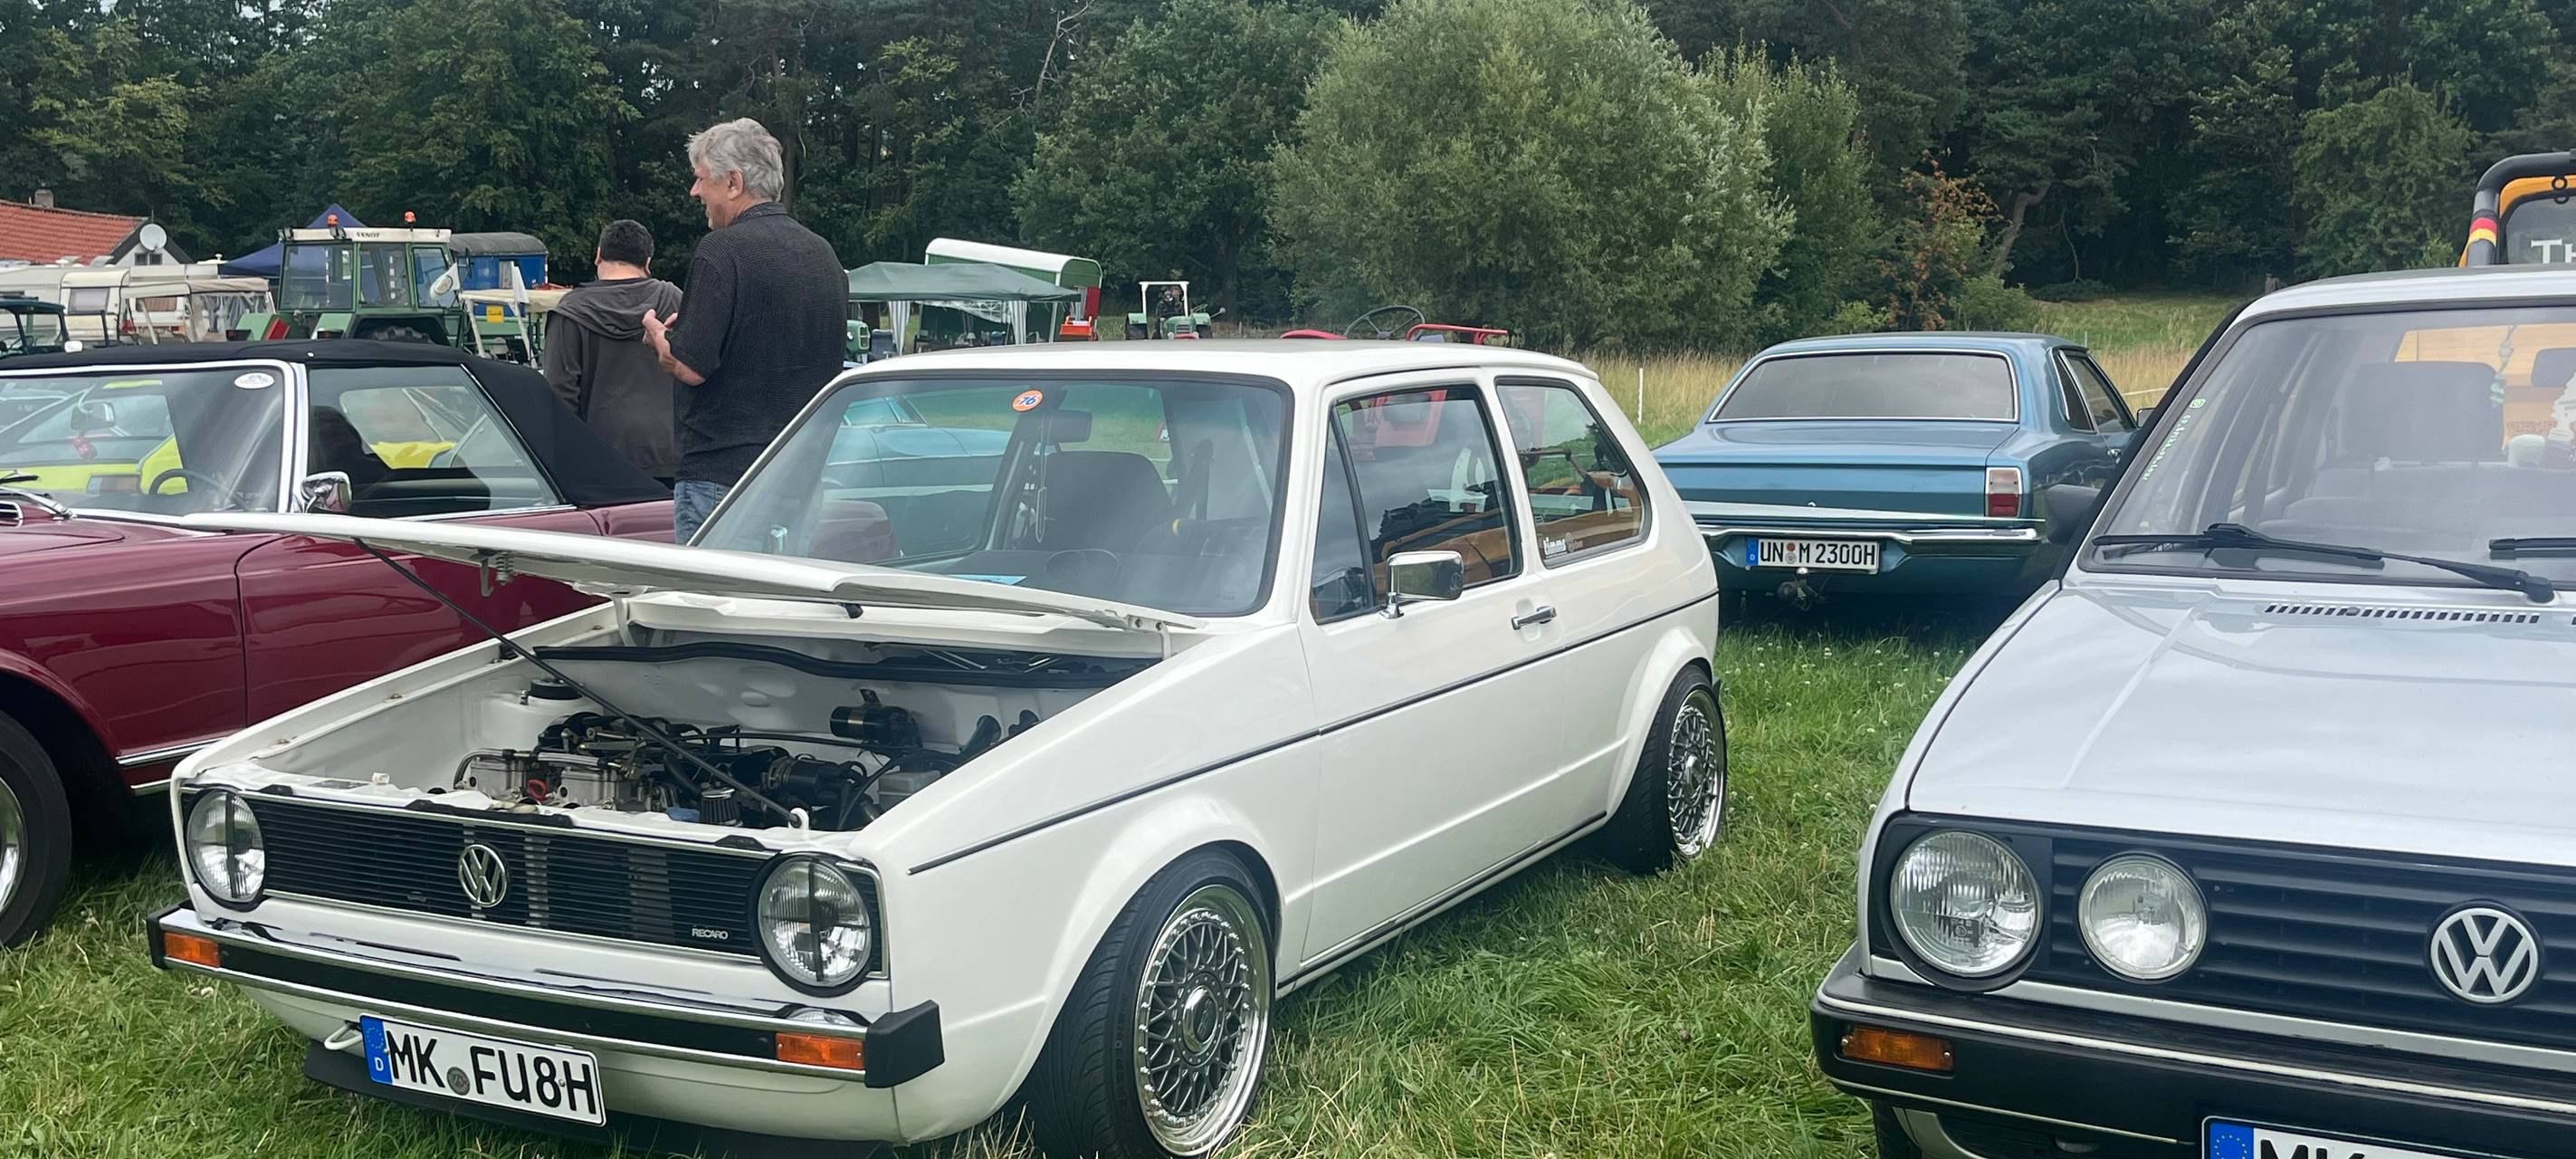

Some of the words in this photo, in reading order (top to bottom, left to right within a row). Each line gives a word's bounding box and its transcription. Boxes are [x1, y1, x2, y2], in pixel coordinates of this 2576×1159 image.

[1760, 541, 1784, 562] UN
[1798, 542, 1811, 563] M
[1815, 543, 1875, 566] 2300H
[692, 927, 729, 940] RECARO
[2430, 908, 2538, 1003] VW
[374, 1056, 385, 1072] D
[386, 1030, 446, 1088] MK
[470, 1045, 597, 1115] FU8H
